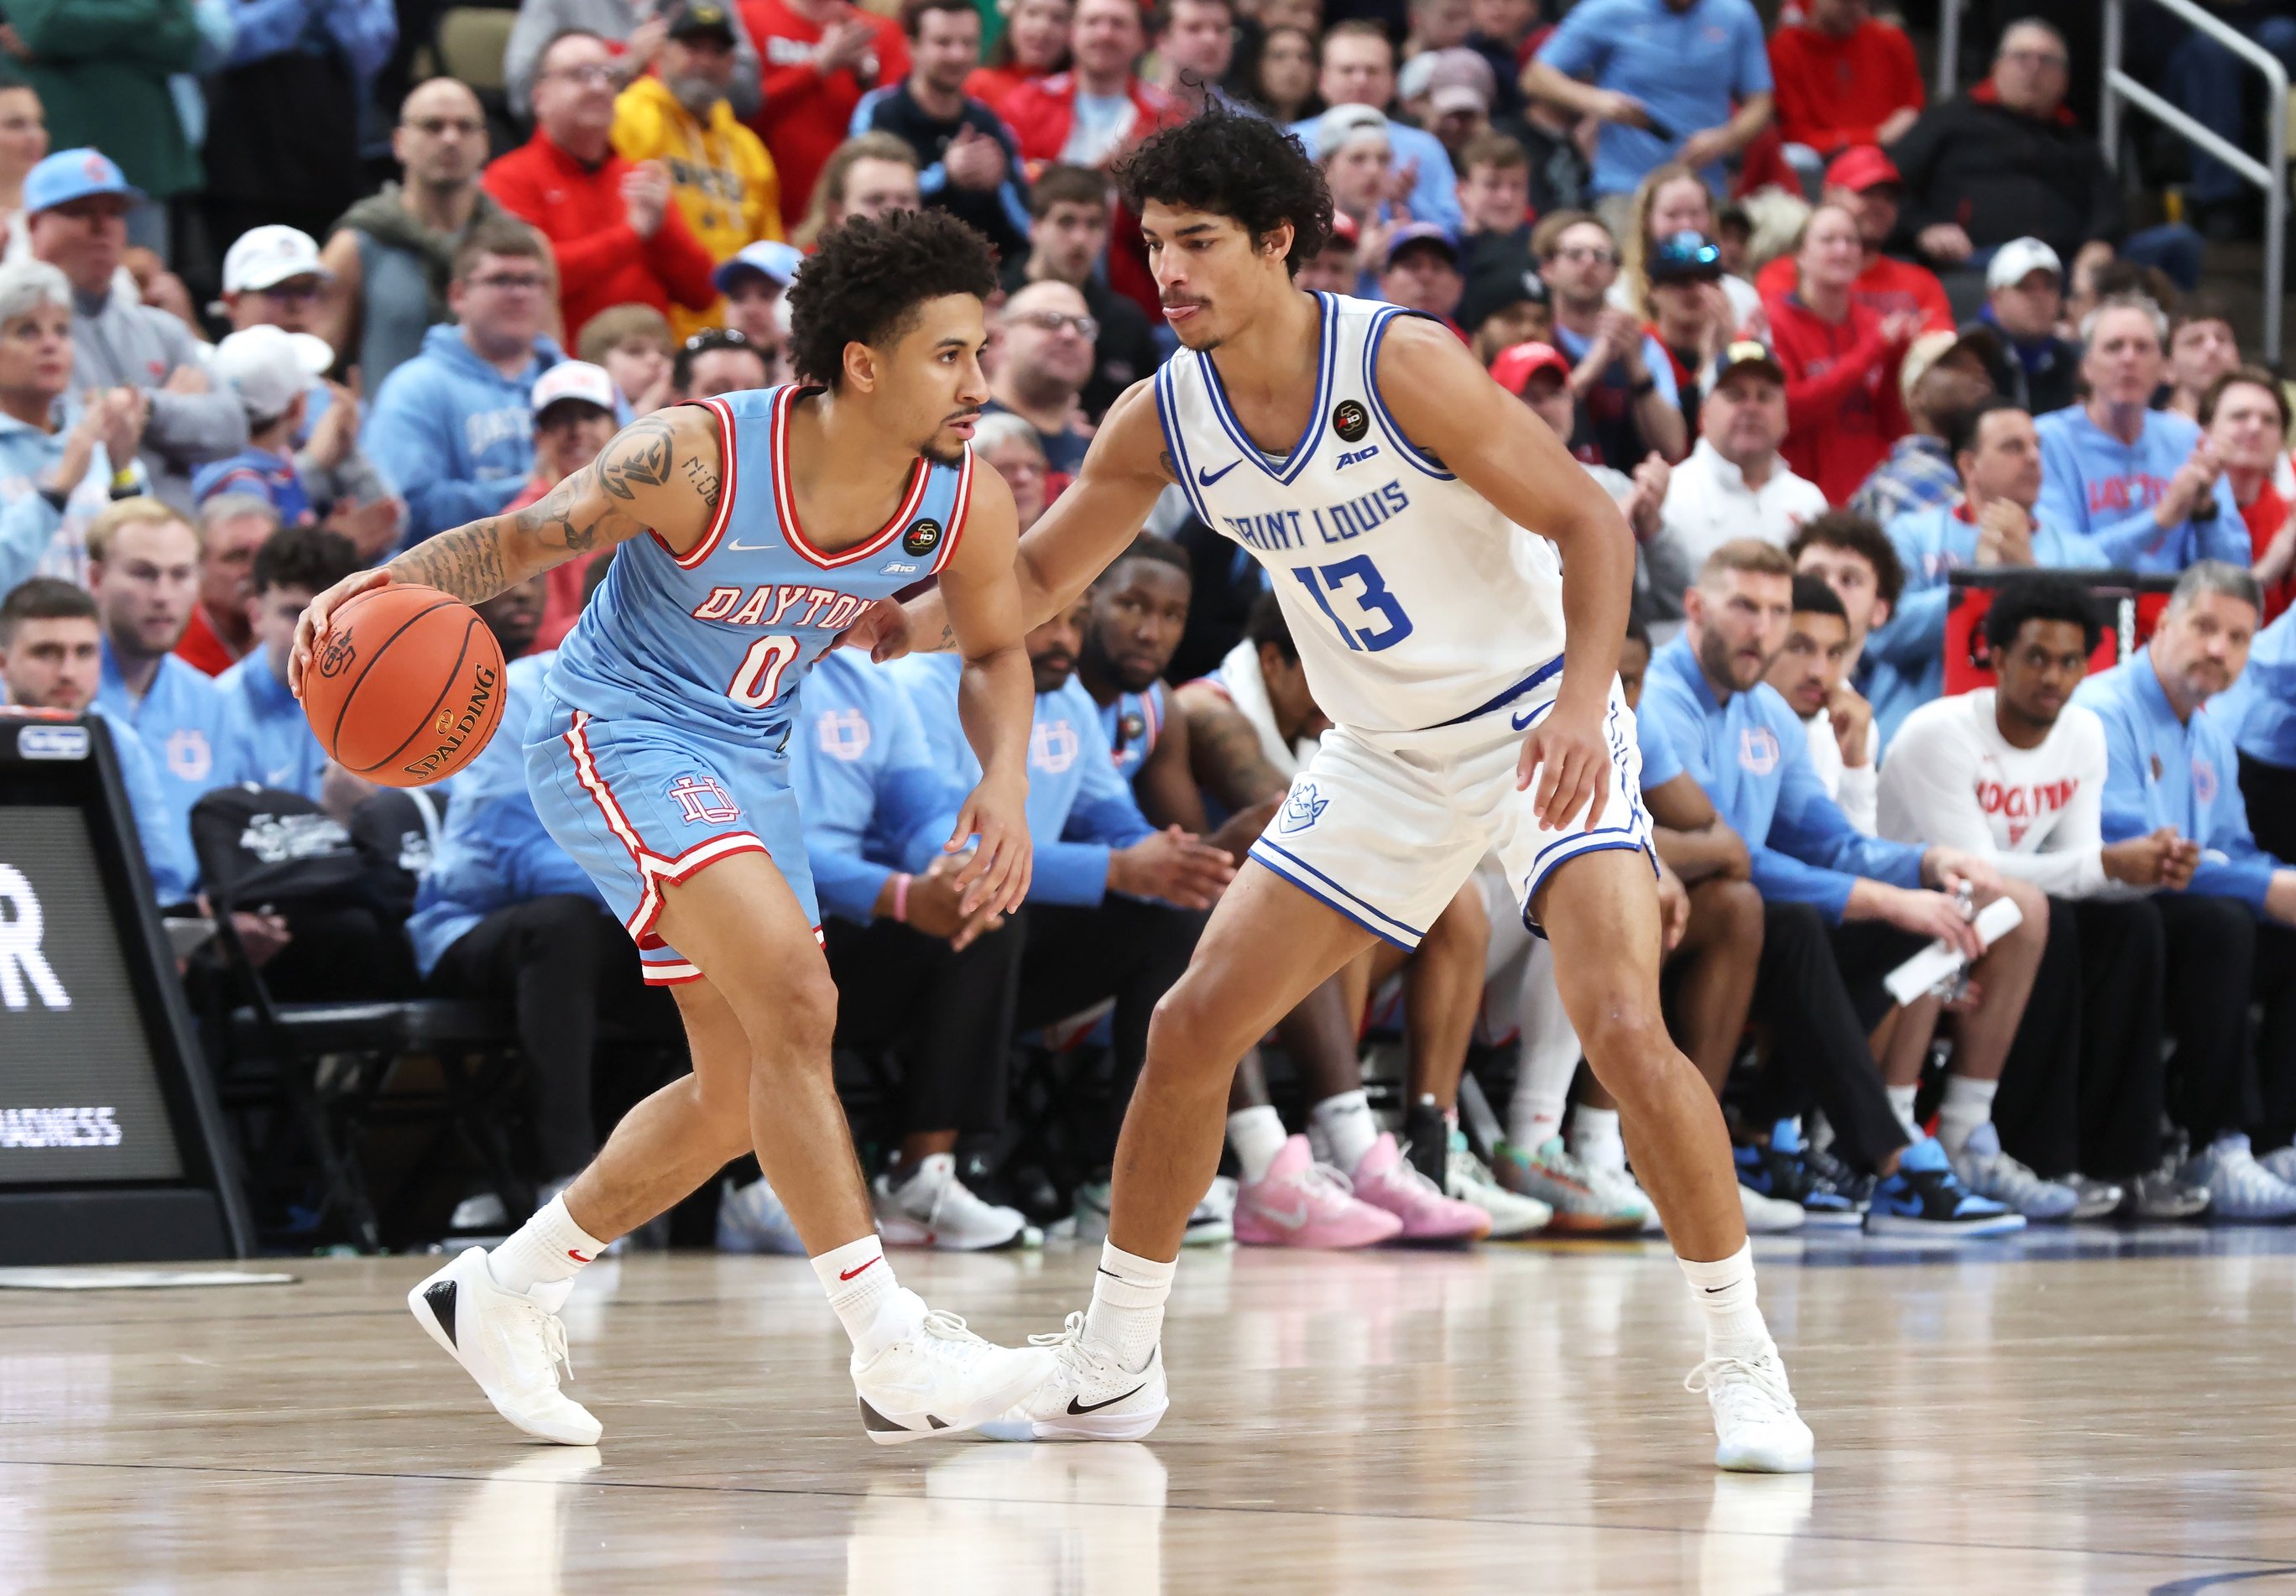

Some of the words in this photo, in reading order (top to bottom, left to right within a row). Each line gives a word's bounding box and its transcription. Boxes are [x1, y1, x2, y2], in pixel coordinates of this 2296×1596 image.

[1336, 445, 1380, 471] A10
[1311, 477, 1411, 545] LOUIS
[883, 563, 917, 573] A10
[1291, 554, 1414, 652] 13
[725, 634, 801, 710] 0
[402, 661, 497, 780] SPALDING
[0, 1107, 123, 1148] ADNESS
